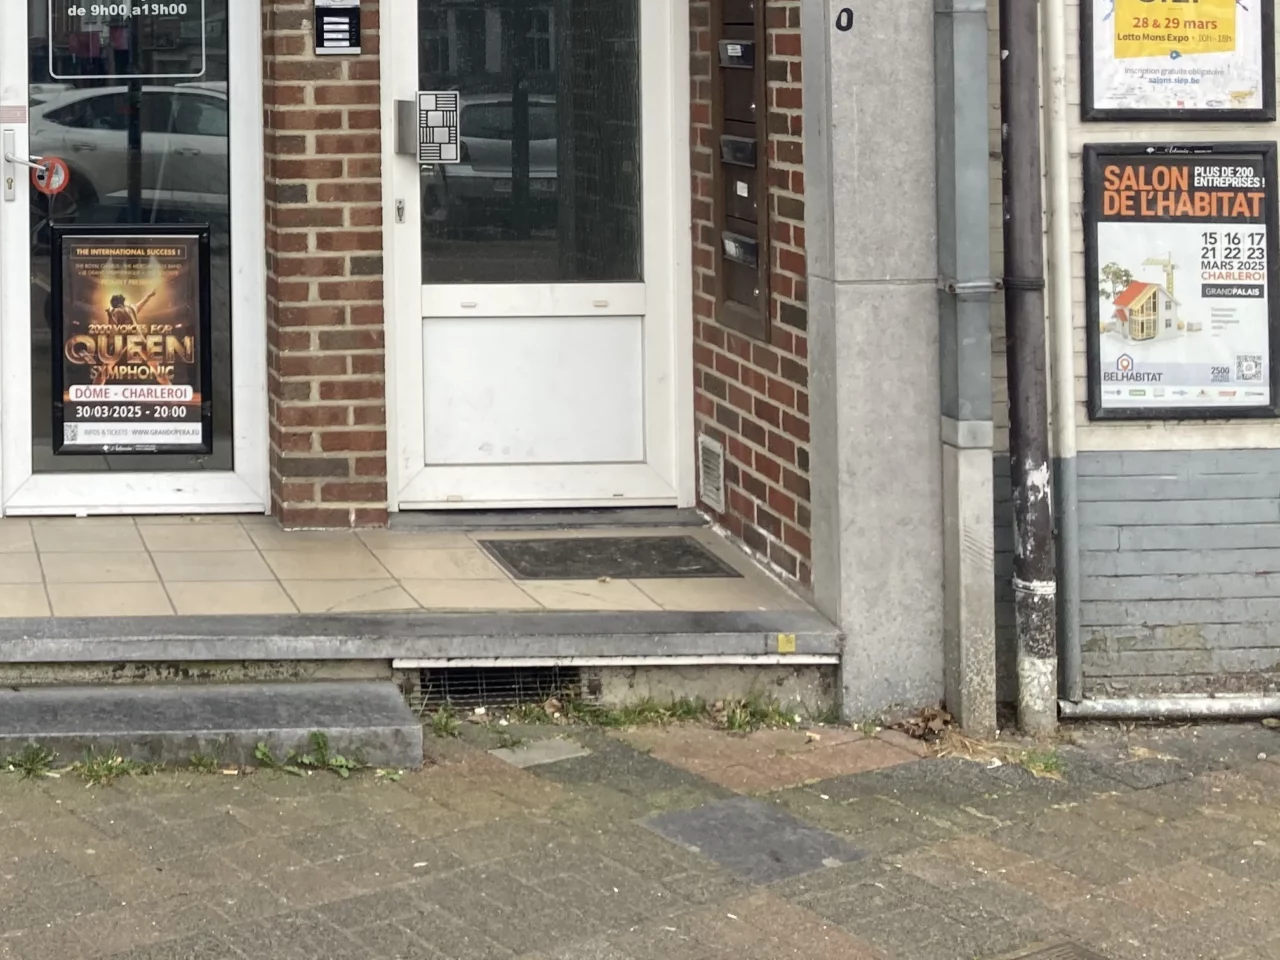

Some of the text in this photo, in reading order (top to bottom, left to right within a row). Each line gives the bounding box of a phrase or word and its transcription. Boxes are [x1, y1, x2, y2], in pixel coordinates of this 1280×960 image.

[67, 5, 87, 16] de
[90, 4, 127, 16] 9h00
[1132, 17, 1218, 30] 28 & 29 mars
[1117, 33, 1141, 41] Lotto
[1142, 34, 1166, 42] Mons
[1167, 34, 1189, 43] Expo
[1124, 67, 1160, 76] Inscription
[1161, 67, 1187, 76] gratuite
[1194, 166, 1254, 177] PLUS DE 200
[1103, 165, 1189, 191] SALON
[1194, 177, 1260, 188] ENTREPRISES
[1103, 190, 1266, 217] DE L'HABITAT
[1201, 232, 1265, 246] 15 16 17
[76, 248, 89, 256] THE
[90, 248, 145, 256] INTERNATIONAL
[146, 248, 176, 256] SUCCESS
[1201, 246, 1265, 260] 21 22 23
[1201, 260, 1265, 270] MARS 2025
[1201, 271, 1265, 281] CHARLEROI
[88, 324, 173, 334] 2000 VOICES FOR
[64, 334, 195, 365] QUEEN
[90, 365, 175, 380] SYMPHONIC
[1210, 366, 1230, 375] 2500
[1103, 371, 1164, 382] BELHABITAT
[75, 385, 111, 399] DÔME
[122, 387, 188, 399] CHARLEROI
[75, 405, 142, 418] 30/03/2025
[153, 405, 187, 418] 20:00
